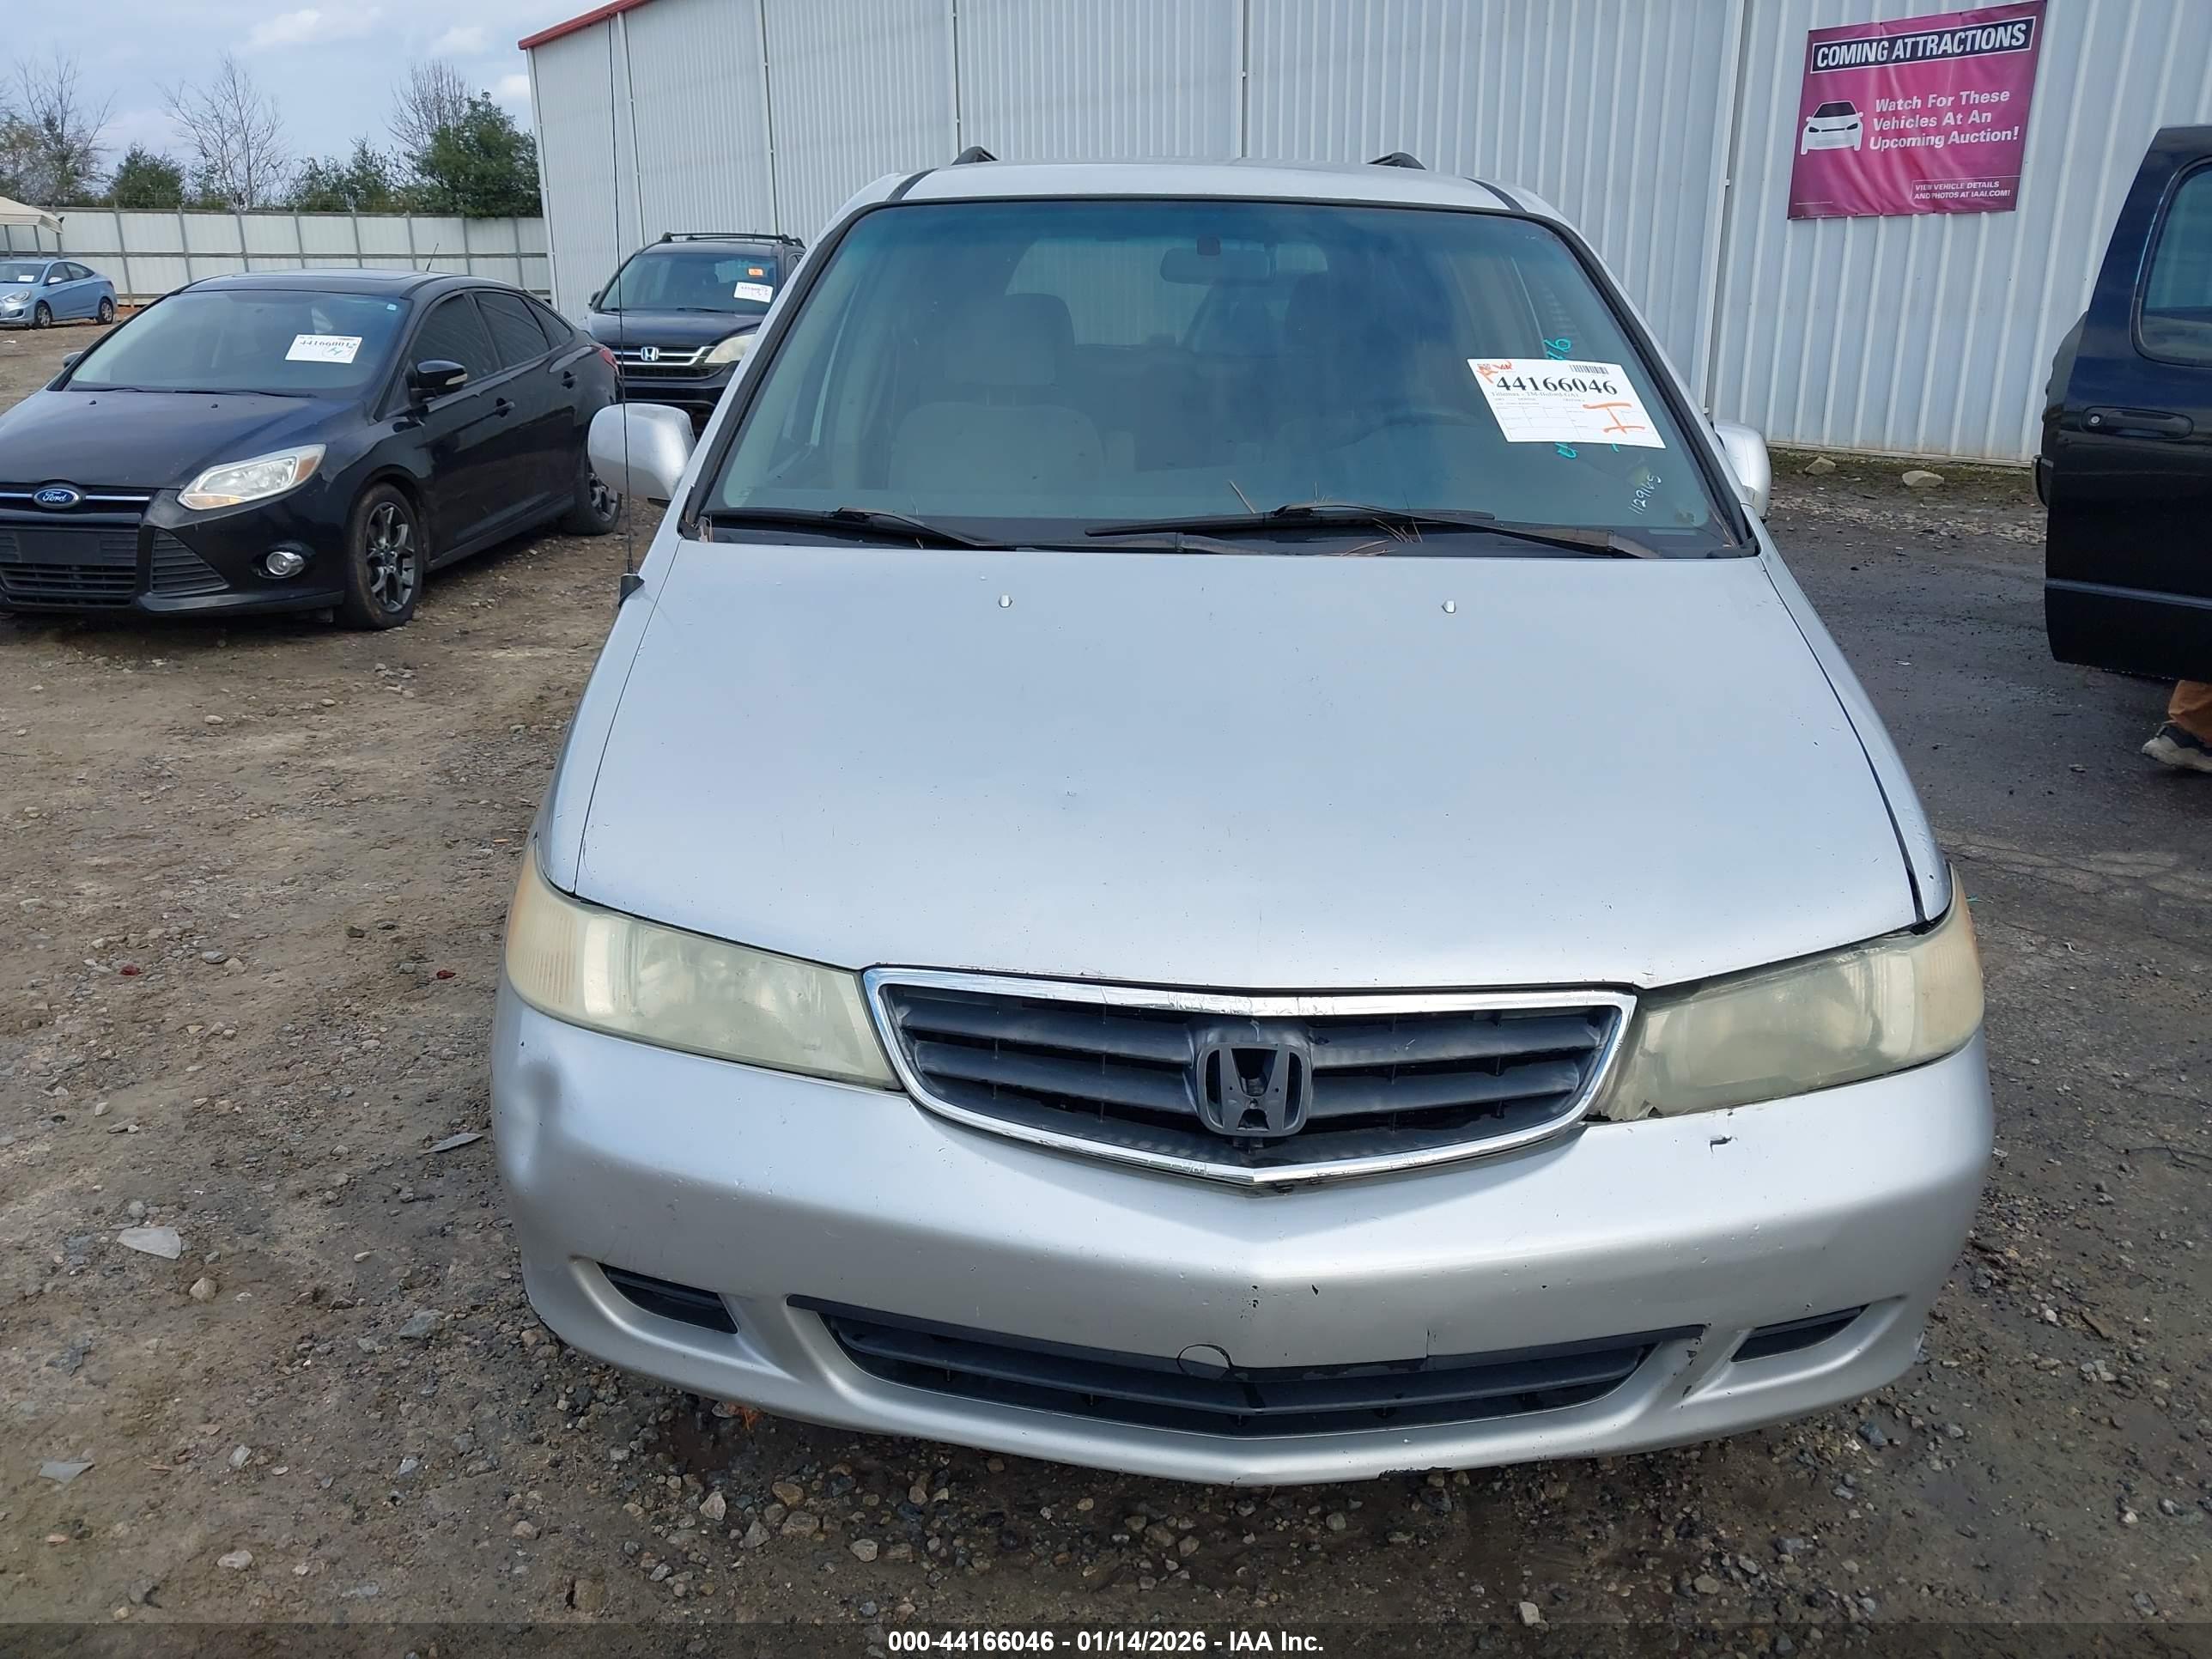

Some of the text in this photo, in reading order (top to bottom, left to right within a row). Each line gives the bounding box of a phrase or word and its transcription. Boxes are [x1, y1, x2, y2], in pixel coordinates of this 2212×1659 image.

[1817, 23, 2027, 68] COMING ATTRACTIONS
[1875, 90, 2010, 112] Watch For These
[1873, 110, 1991, 131] Vehicles At An
[1869, 125, 2020, 151] Upcoming Auction!
[1933, 182, 1966, 191] VEHICLE
[1966, 180, 2000, 189] DETAILS
[1496, 376, 1618, 395] 44166046
[42, 490, 68, 502] Ford
